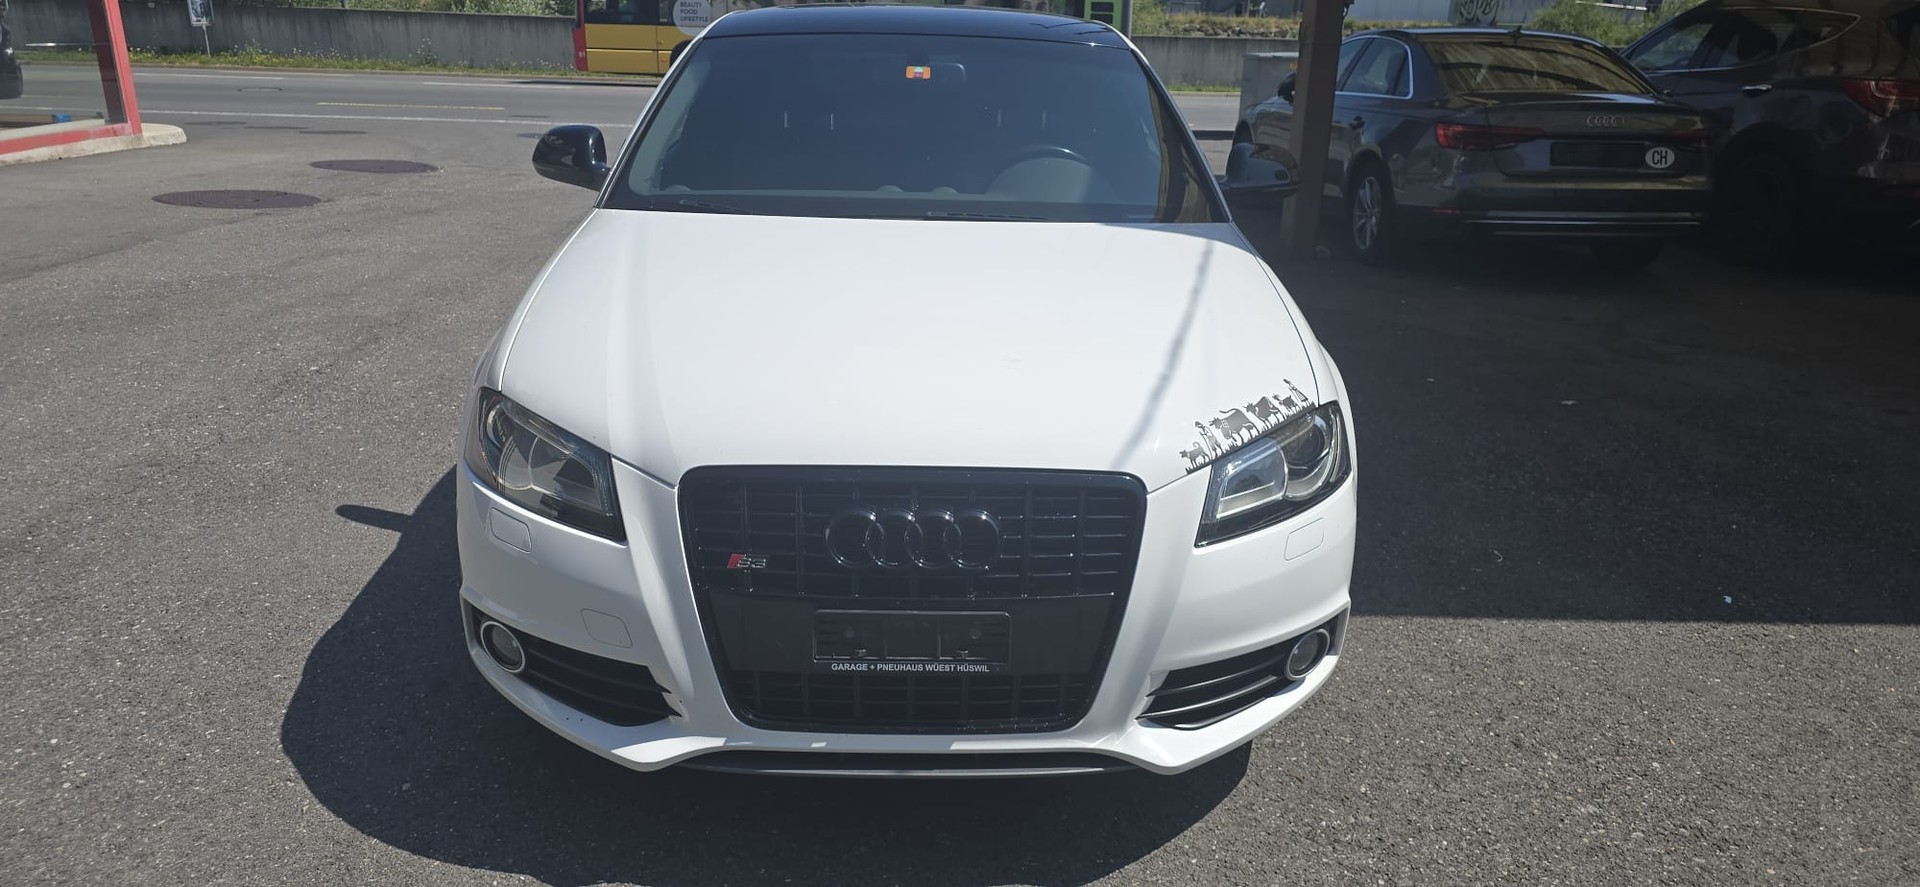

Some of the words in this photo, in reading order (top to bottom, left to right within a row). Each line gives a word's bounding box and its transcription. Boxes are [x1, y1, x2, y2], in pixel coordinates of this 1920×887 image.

[1652, 150, 1668, 165] CH
[831, 663, 869, 671] GARAGE
[877, 663, 924, 672] PNEUHAUS
[925, 662, 956, 672] WÜEST
[957, 662, 990, 672] HÜSWIL
